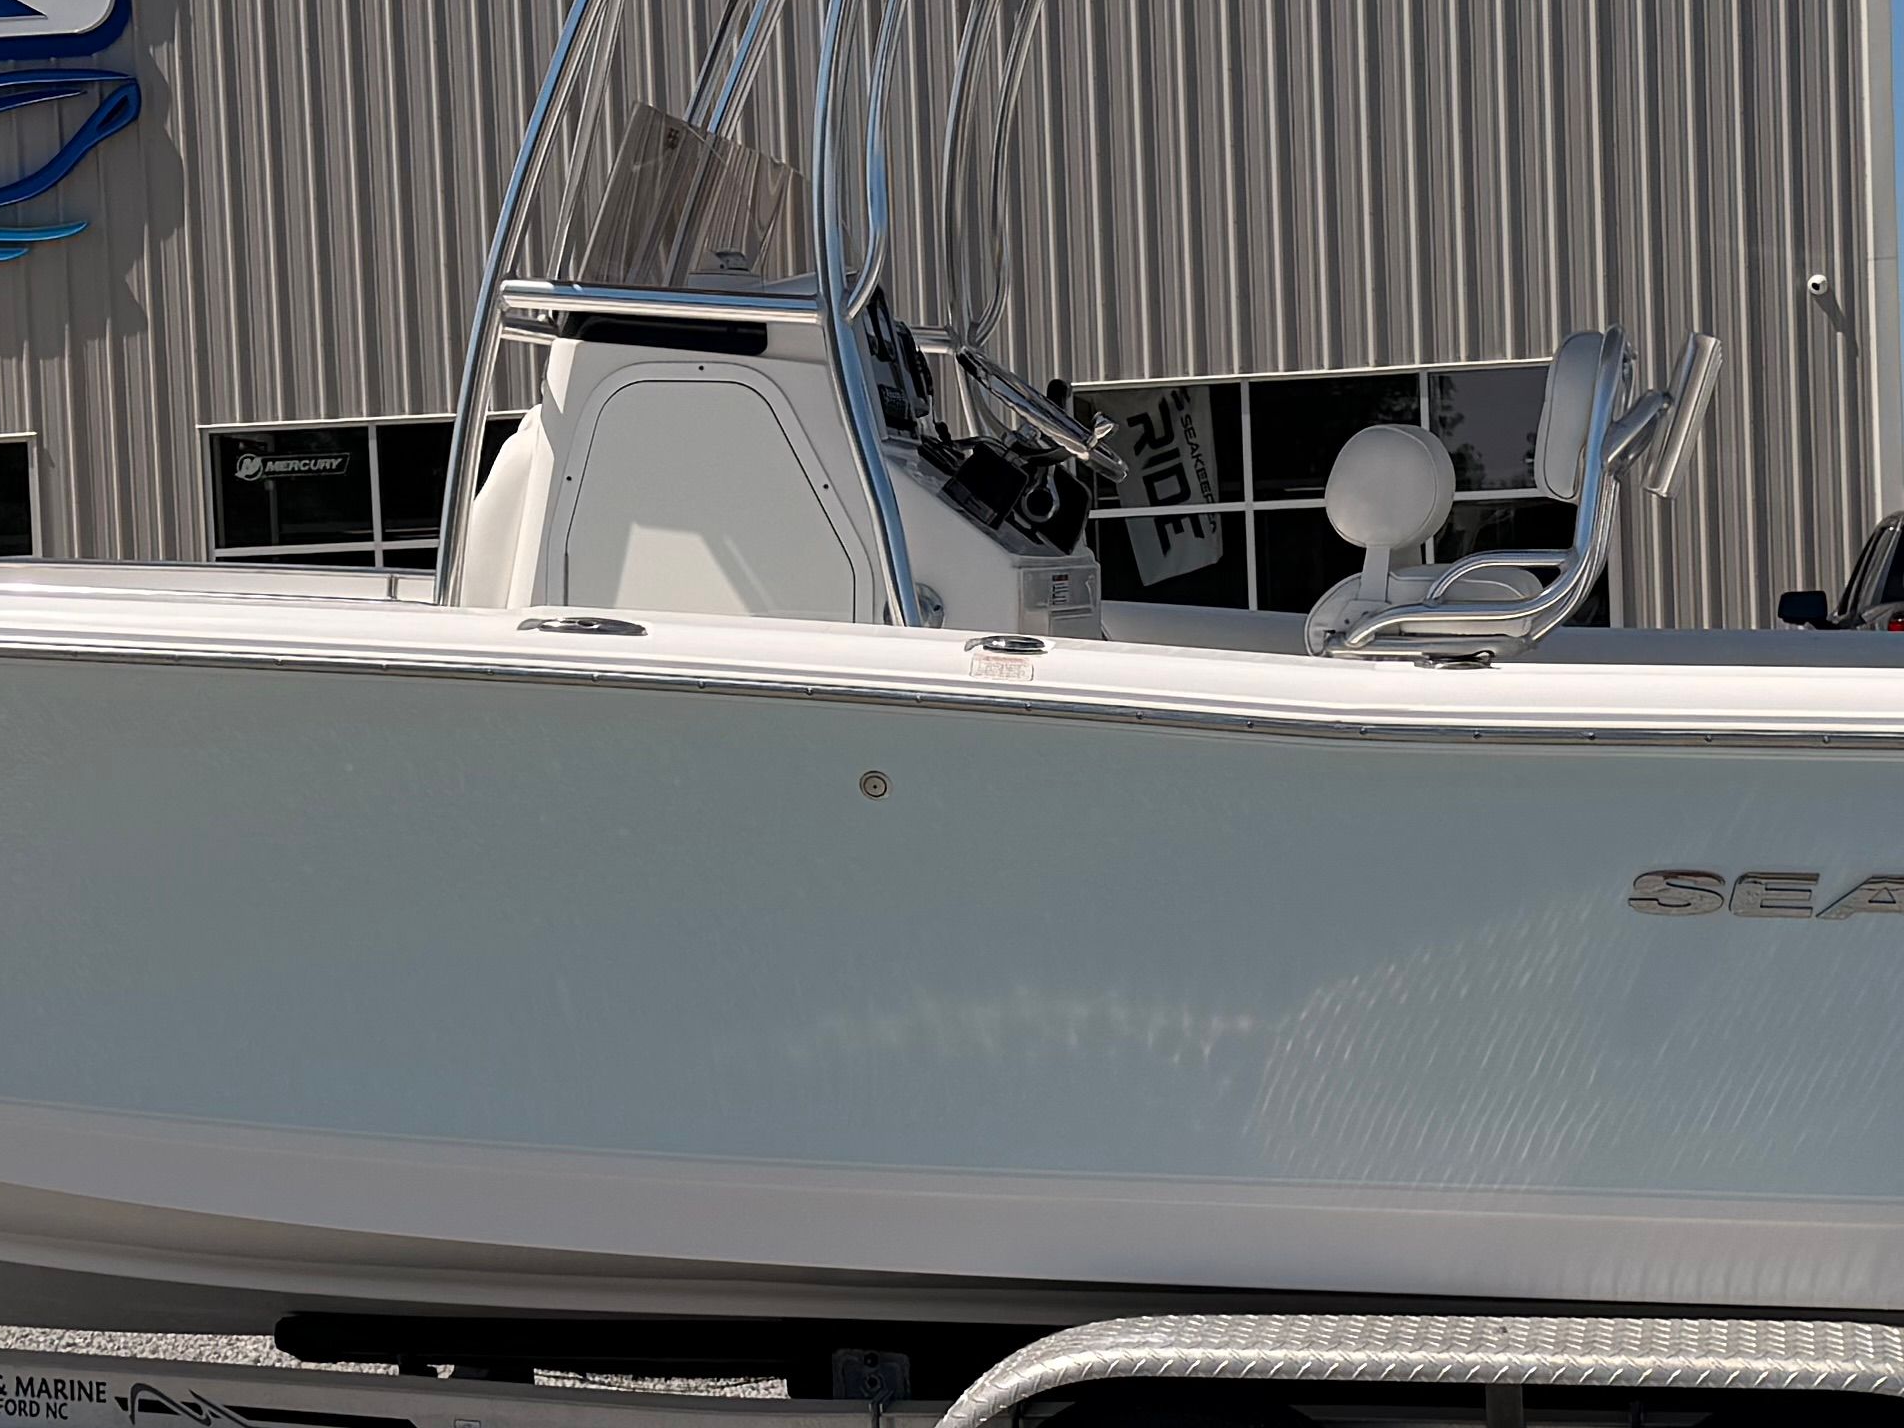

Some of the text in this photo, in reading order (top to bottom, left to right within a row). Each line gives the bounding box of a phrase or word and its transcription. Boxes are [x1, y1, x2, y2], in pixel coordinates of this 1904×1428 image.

[264, 458, 344, 472] MERCURY
[1126, 394, 1206, 558] RIDE
[14, 1375, 107, 1404] MARINE
[44, 1401, 69, 1421] NC
